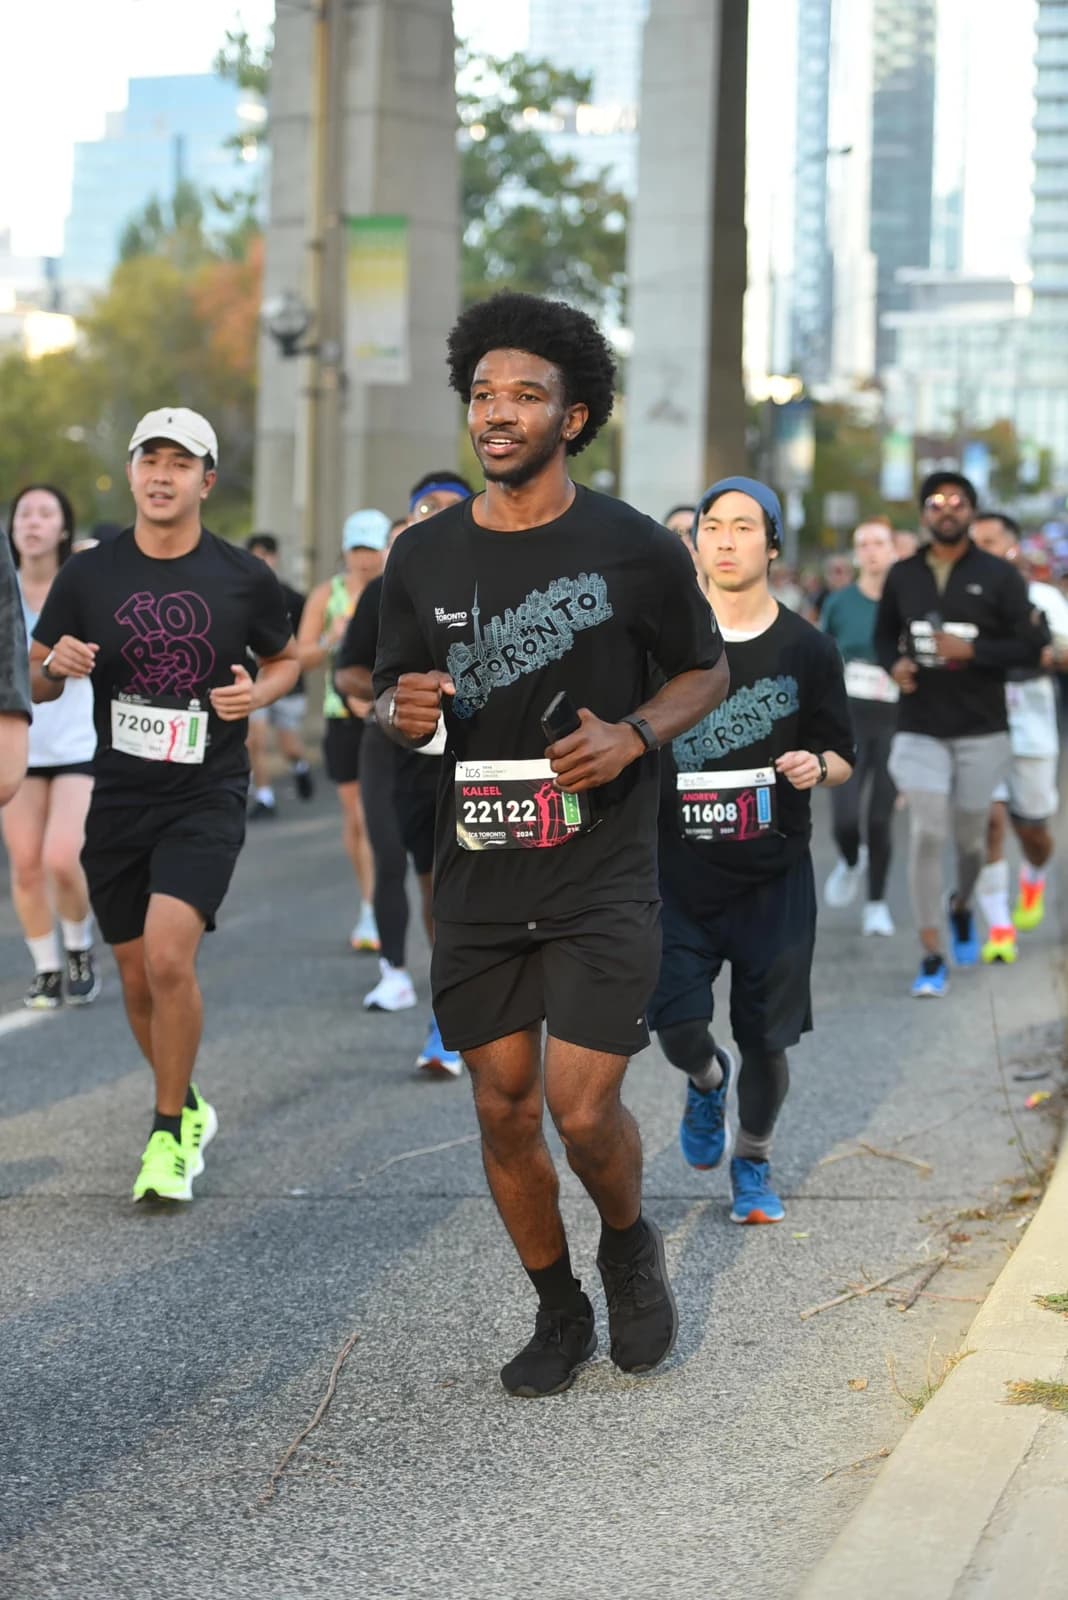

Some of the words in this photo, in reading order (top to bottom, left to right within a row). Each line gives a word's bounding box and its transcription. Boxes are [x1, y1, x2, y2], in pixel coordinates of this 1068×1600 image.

[436, 611, 467, 622] TORONTO
[460, 592, 597, 688] TORONTO
[117, 712, 165, 735] 7200
[684, 691, 789, 756] TORONTO
[462, 786, 502, 797] KALEEL
[682, 792, 718, 801] ANDREW
[463, 799, 537, 824] 22122
[682, 803, 738, 823] 11608
[479, 831, 506, 839] TORONTO
[516, 830, 534, 838] 2024
